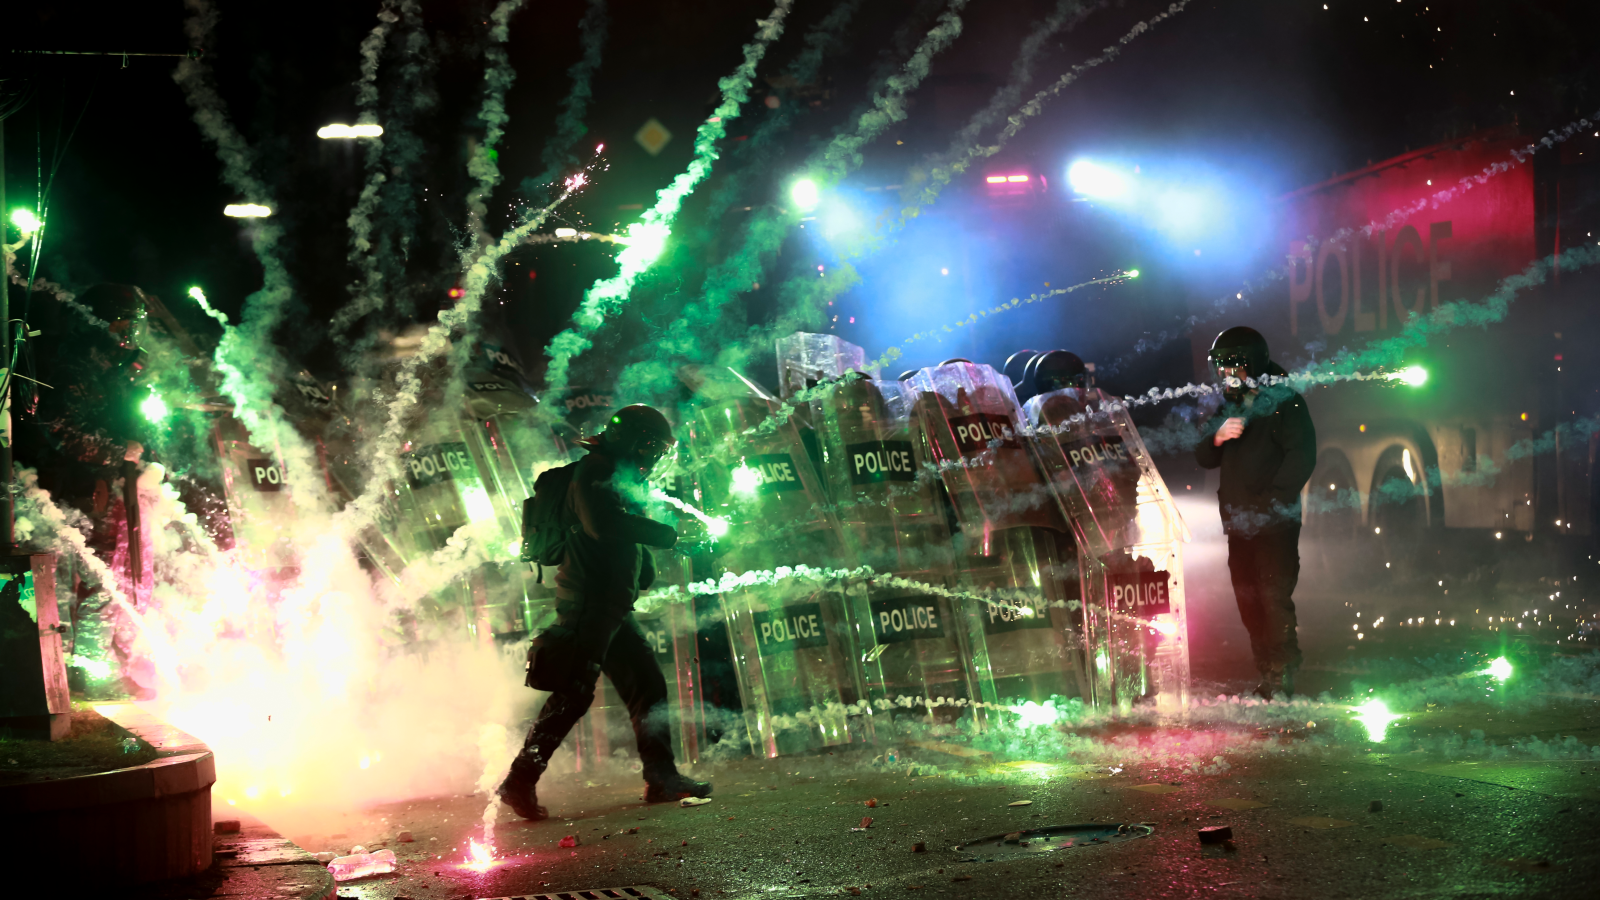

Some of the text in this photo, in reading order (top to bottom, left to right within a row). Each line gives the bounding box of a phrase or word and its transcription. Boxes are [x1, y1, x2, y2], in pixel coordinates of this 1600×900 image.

[1290, 221, 1452, 336] POLICE
[957, 422, 1013, 444] POLICE
[410, 451, 471, 479] POLICE
[854, 450, 912, 475] POLICE
[1069, 443, 1127, 467] POLICE
[255, 466, 288, 484] POL
[748, 462, 795, 486] OLICE
[1113, 581, 1165, 610] POLICE
[761, 614, 820, 645] POLICE
[879, 606, 938, 633] POLICE
